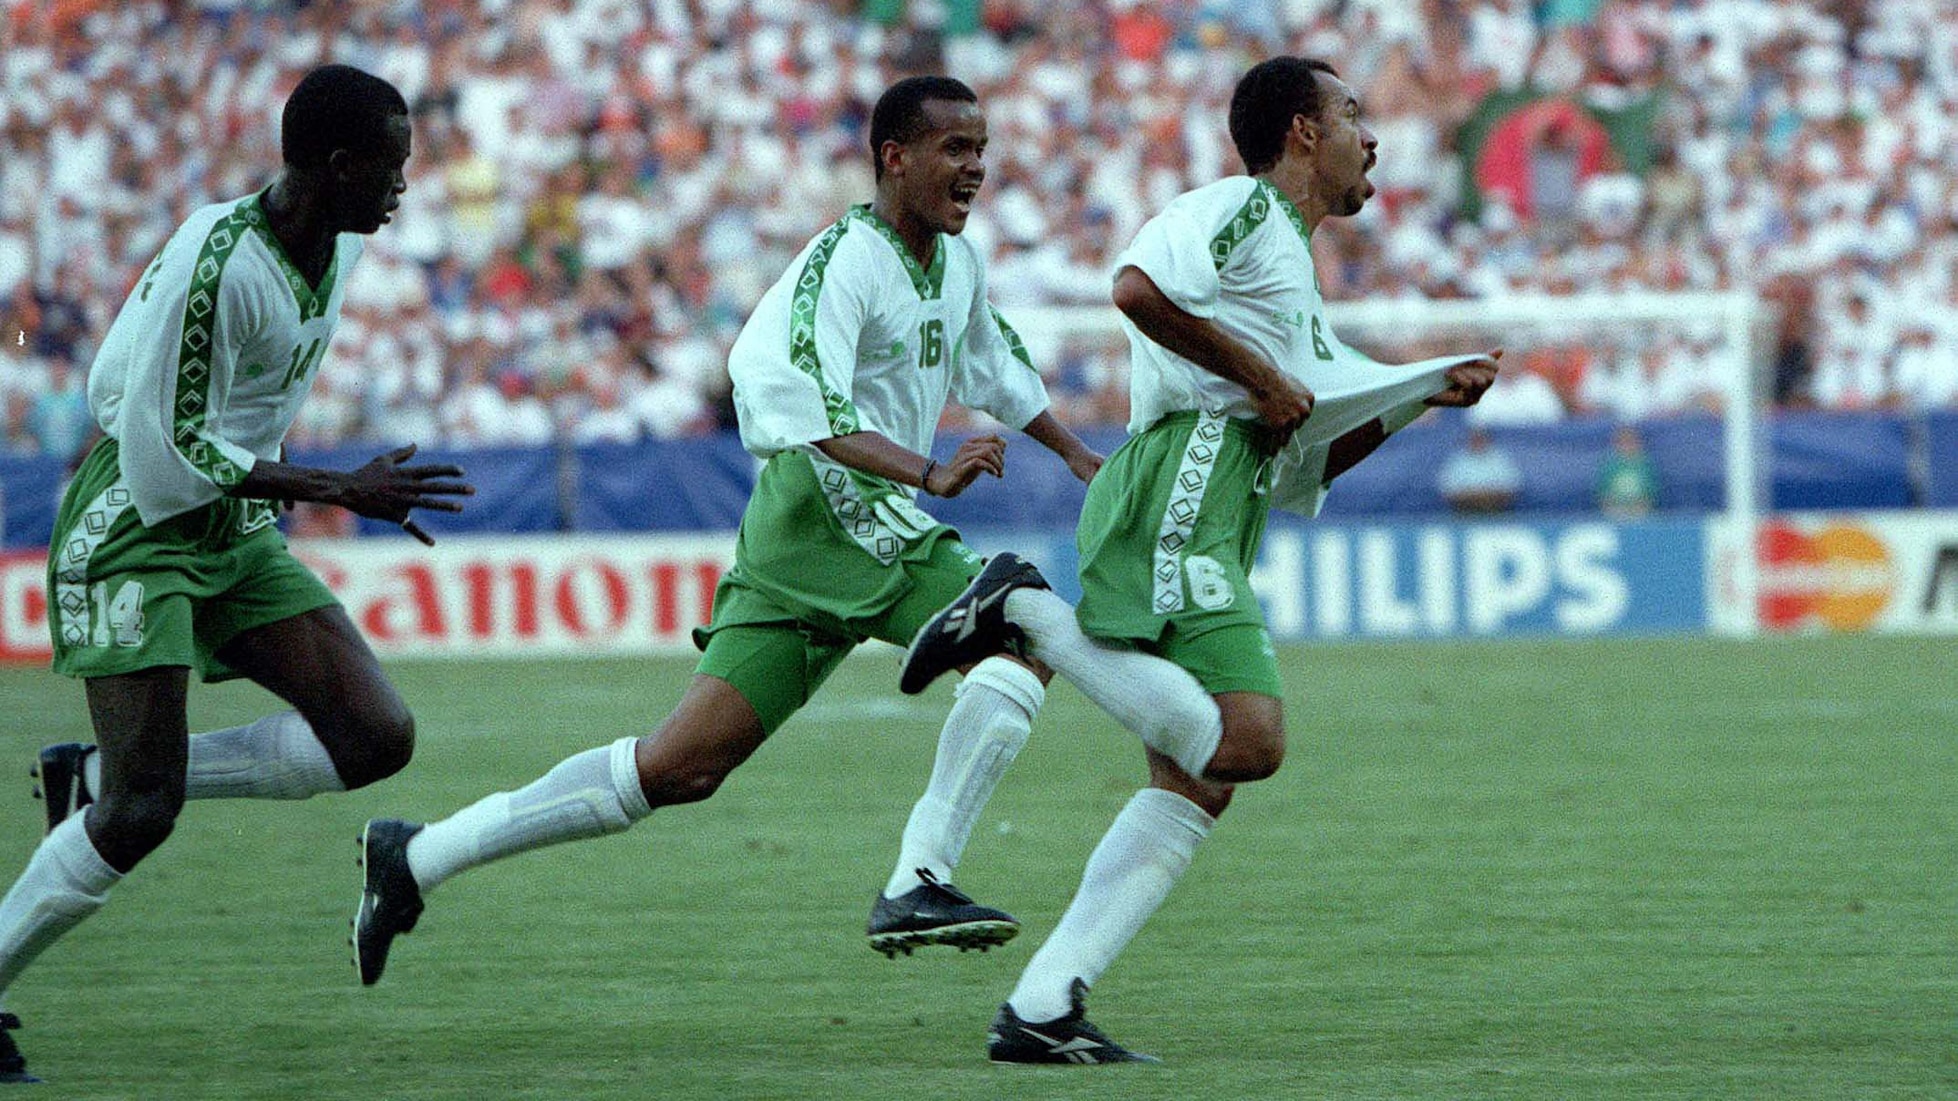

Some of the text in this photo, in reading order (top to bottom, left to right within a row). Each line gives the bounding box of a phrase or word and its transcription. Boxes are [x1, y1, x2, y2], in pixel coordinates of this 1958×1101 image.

[281, 337, 320, 390] 14
[919, 319, 943, 369] 16
[1311, 313, 1334, 361] 6
[297, 552, 723, 640] anon
[1185, 554, 1235, 610] 6
[1249, 523, 1629, 637] HILIPS
[91, 580, 145, 647] 14
